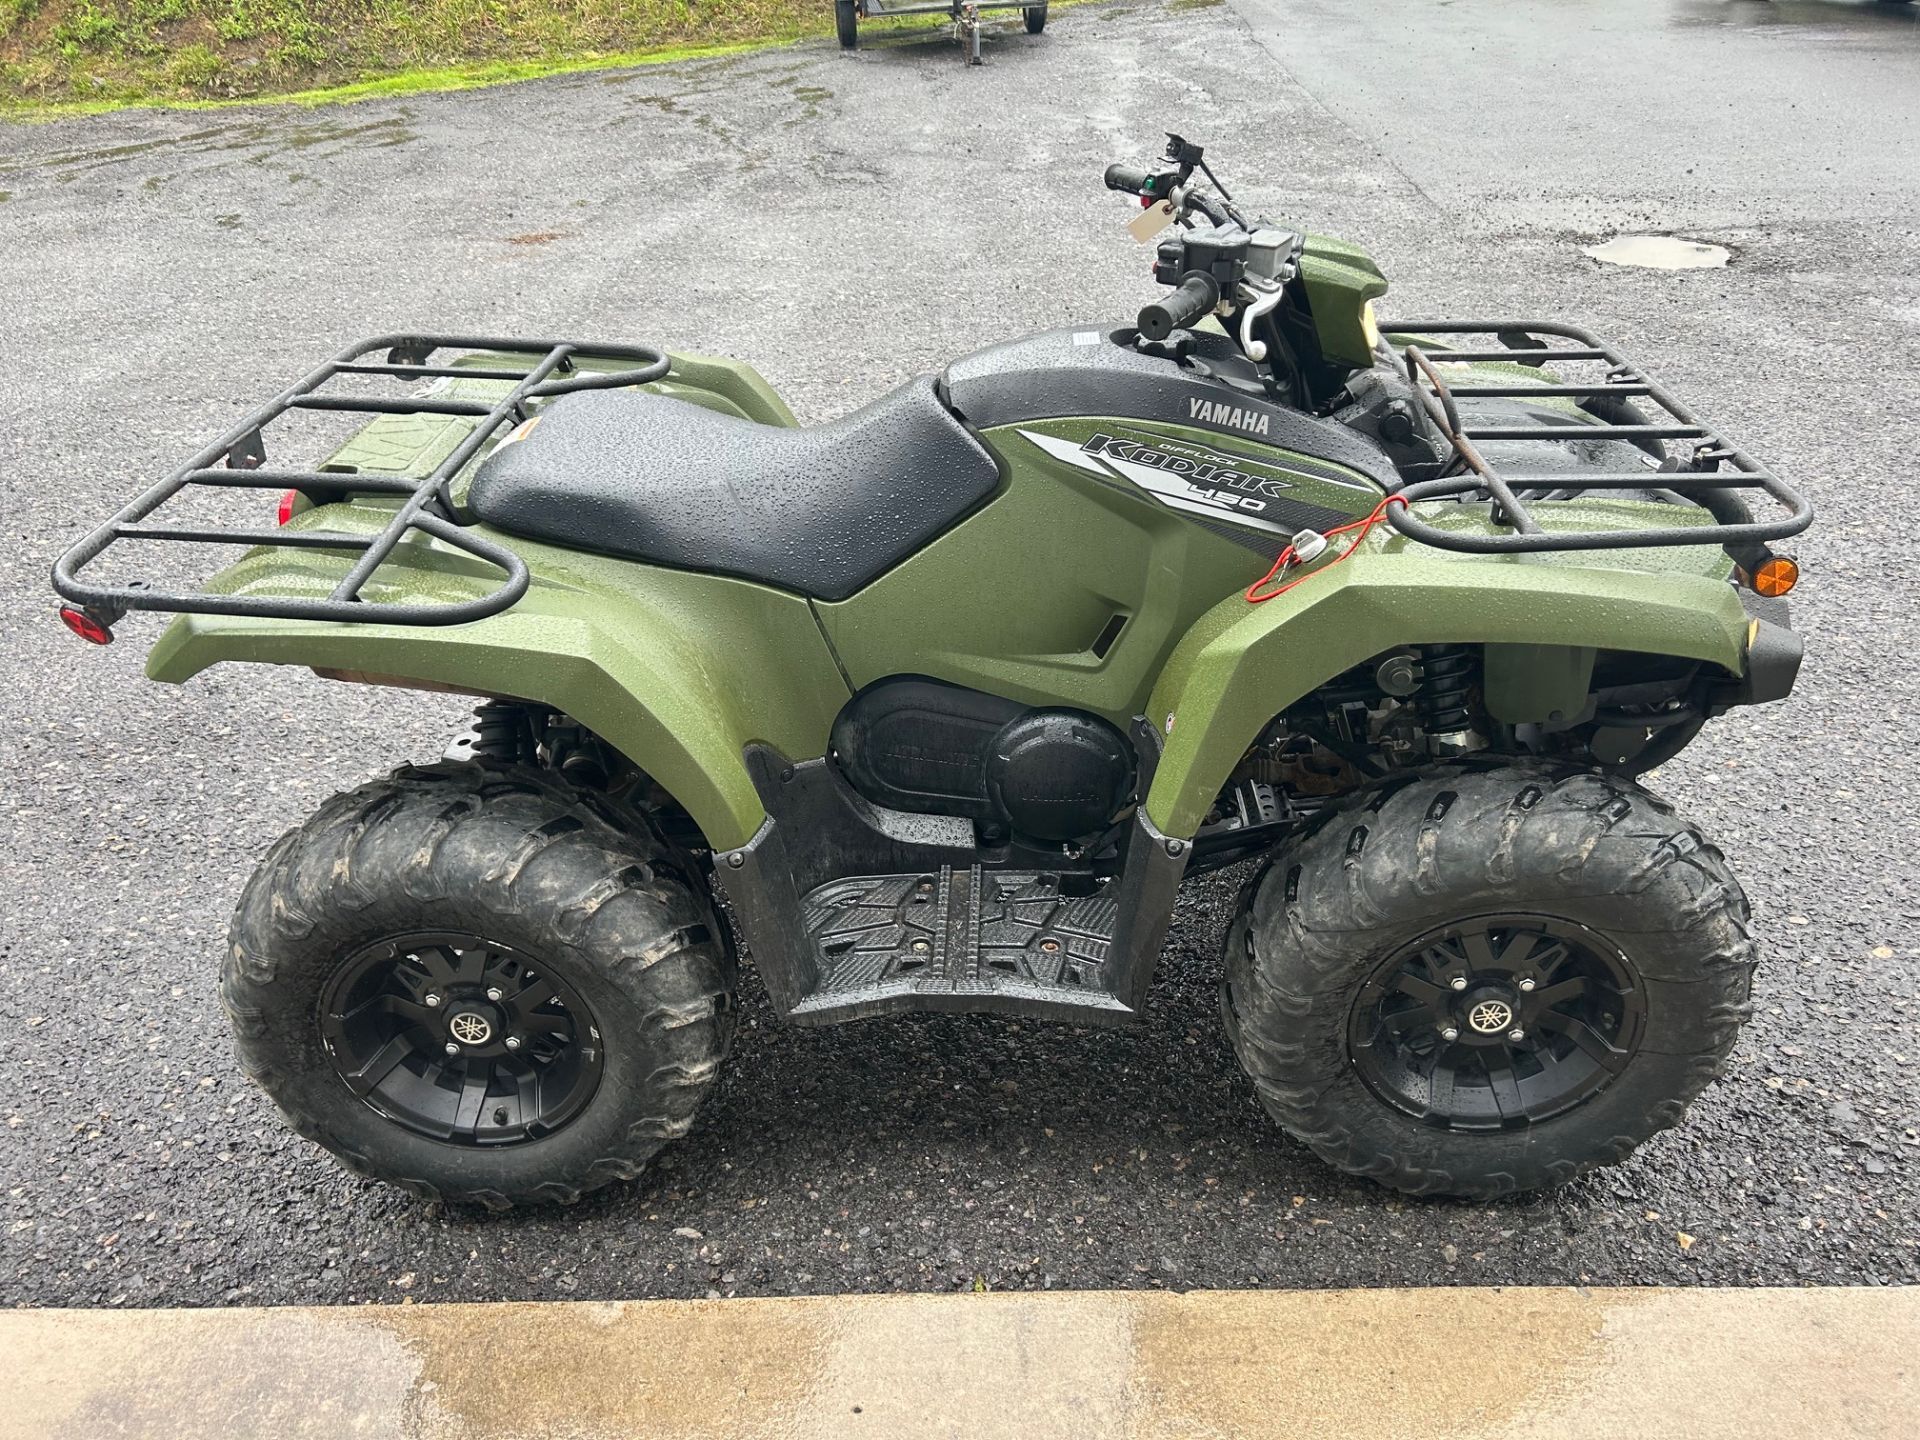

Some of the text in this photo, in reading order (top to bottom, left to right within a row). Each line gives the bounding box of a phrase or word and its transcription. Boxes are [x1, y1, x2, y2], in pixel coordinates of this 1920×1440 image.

[1190, 397, 1269, 435] YAMAHA
[1081, 433, 1295, 498] KODIAK
[1187, 484, 1267, 511] 450
